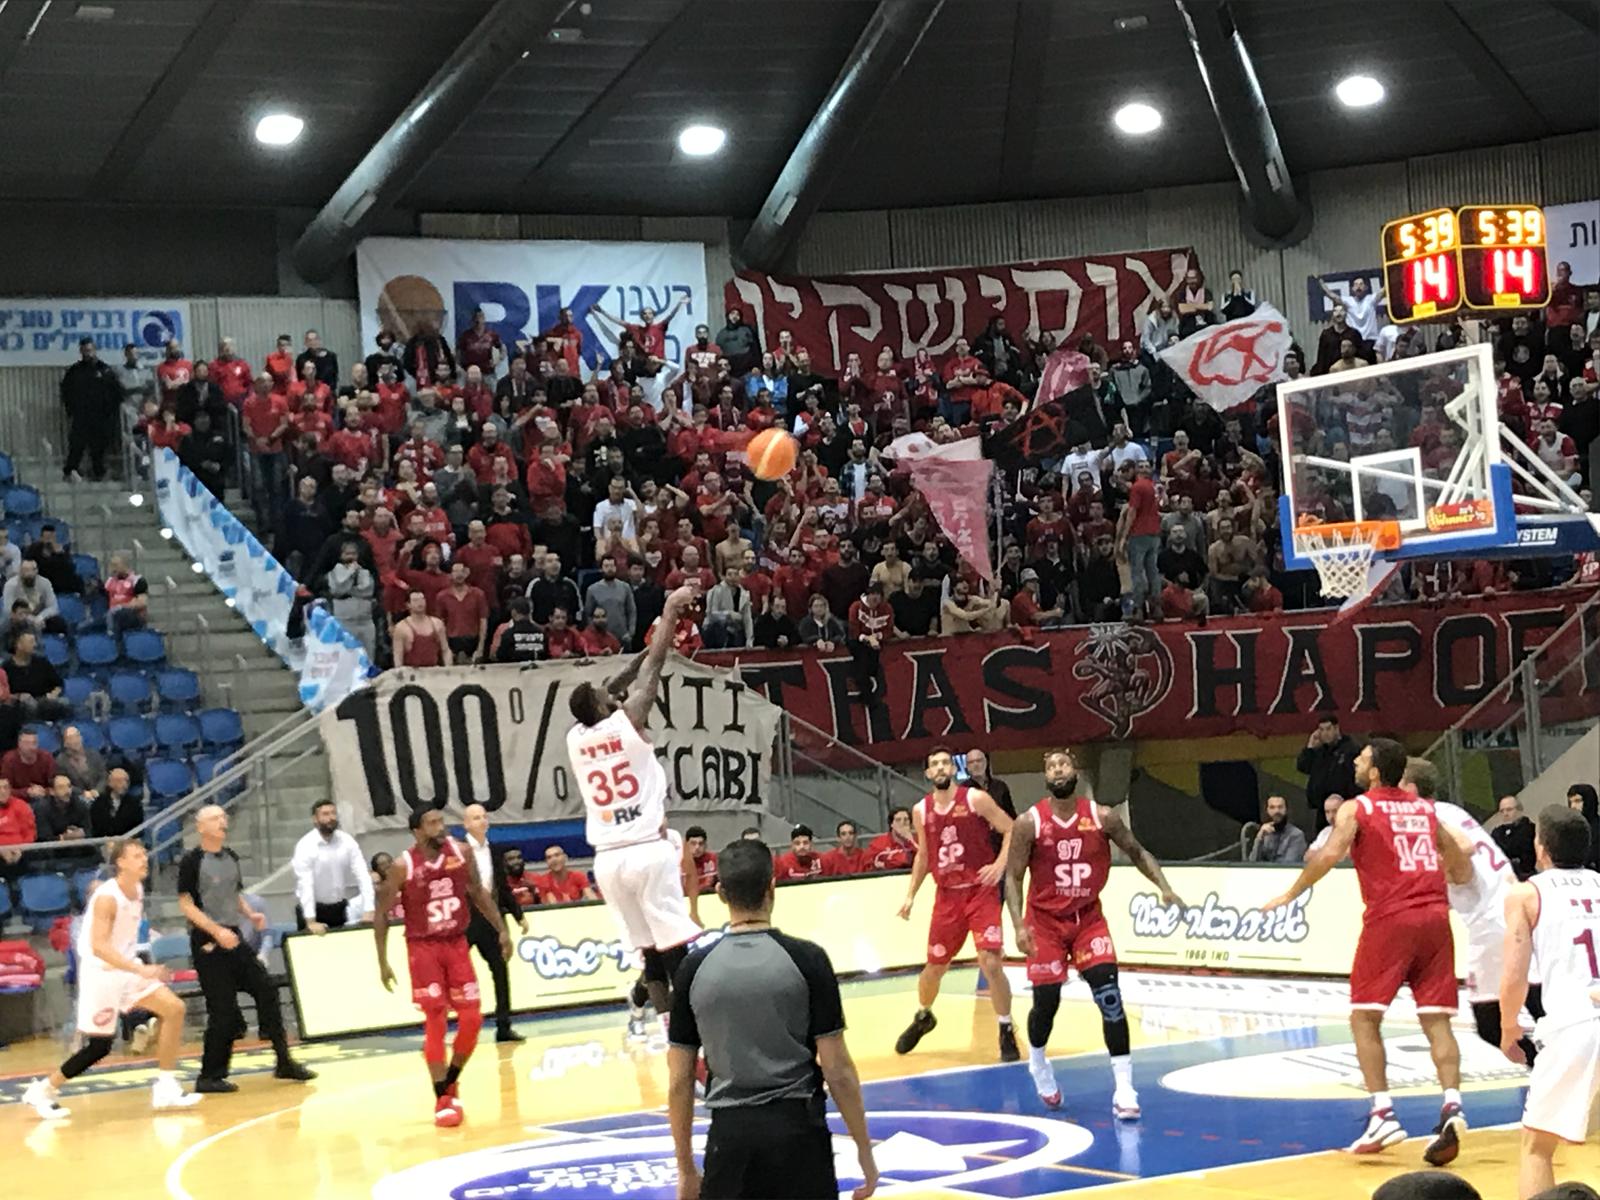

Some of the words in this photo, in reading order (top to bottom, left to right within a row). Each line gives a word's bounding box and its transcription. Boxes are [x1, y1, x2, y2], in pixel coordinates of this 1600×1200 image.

[1399, 212, 1455, 258] 5:39
[1478, 209, 1541, 246] 5:39
[1569, 218, 1598, 249] ות
[1413, 254, 1448, 304] 14
[1493, 249, 1532, 295] 14
[453, 281, 613, 372] RK
[733, 252, 1190, 372] אוסישקין
[1516, 528, 1558, 543] YSTEM
[740, 641, 1056, 748] TRAS
[1185, 603, 1600, 720] HAPOE
[643, 671, 747, 733] NTI
[586, 760, 641, 807] 35
[613, 803, 643, 825] RK
[937, 842, 965, 868] SP
[1056, 837, 1083, 861] 97
[1393, 833, 1439, 873] 14
[1053, 862, 1092, 888] SP
[426, 896, 462, 923] SP
